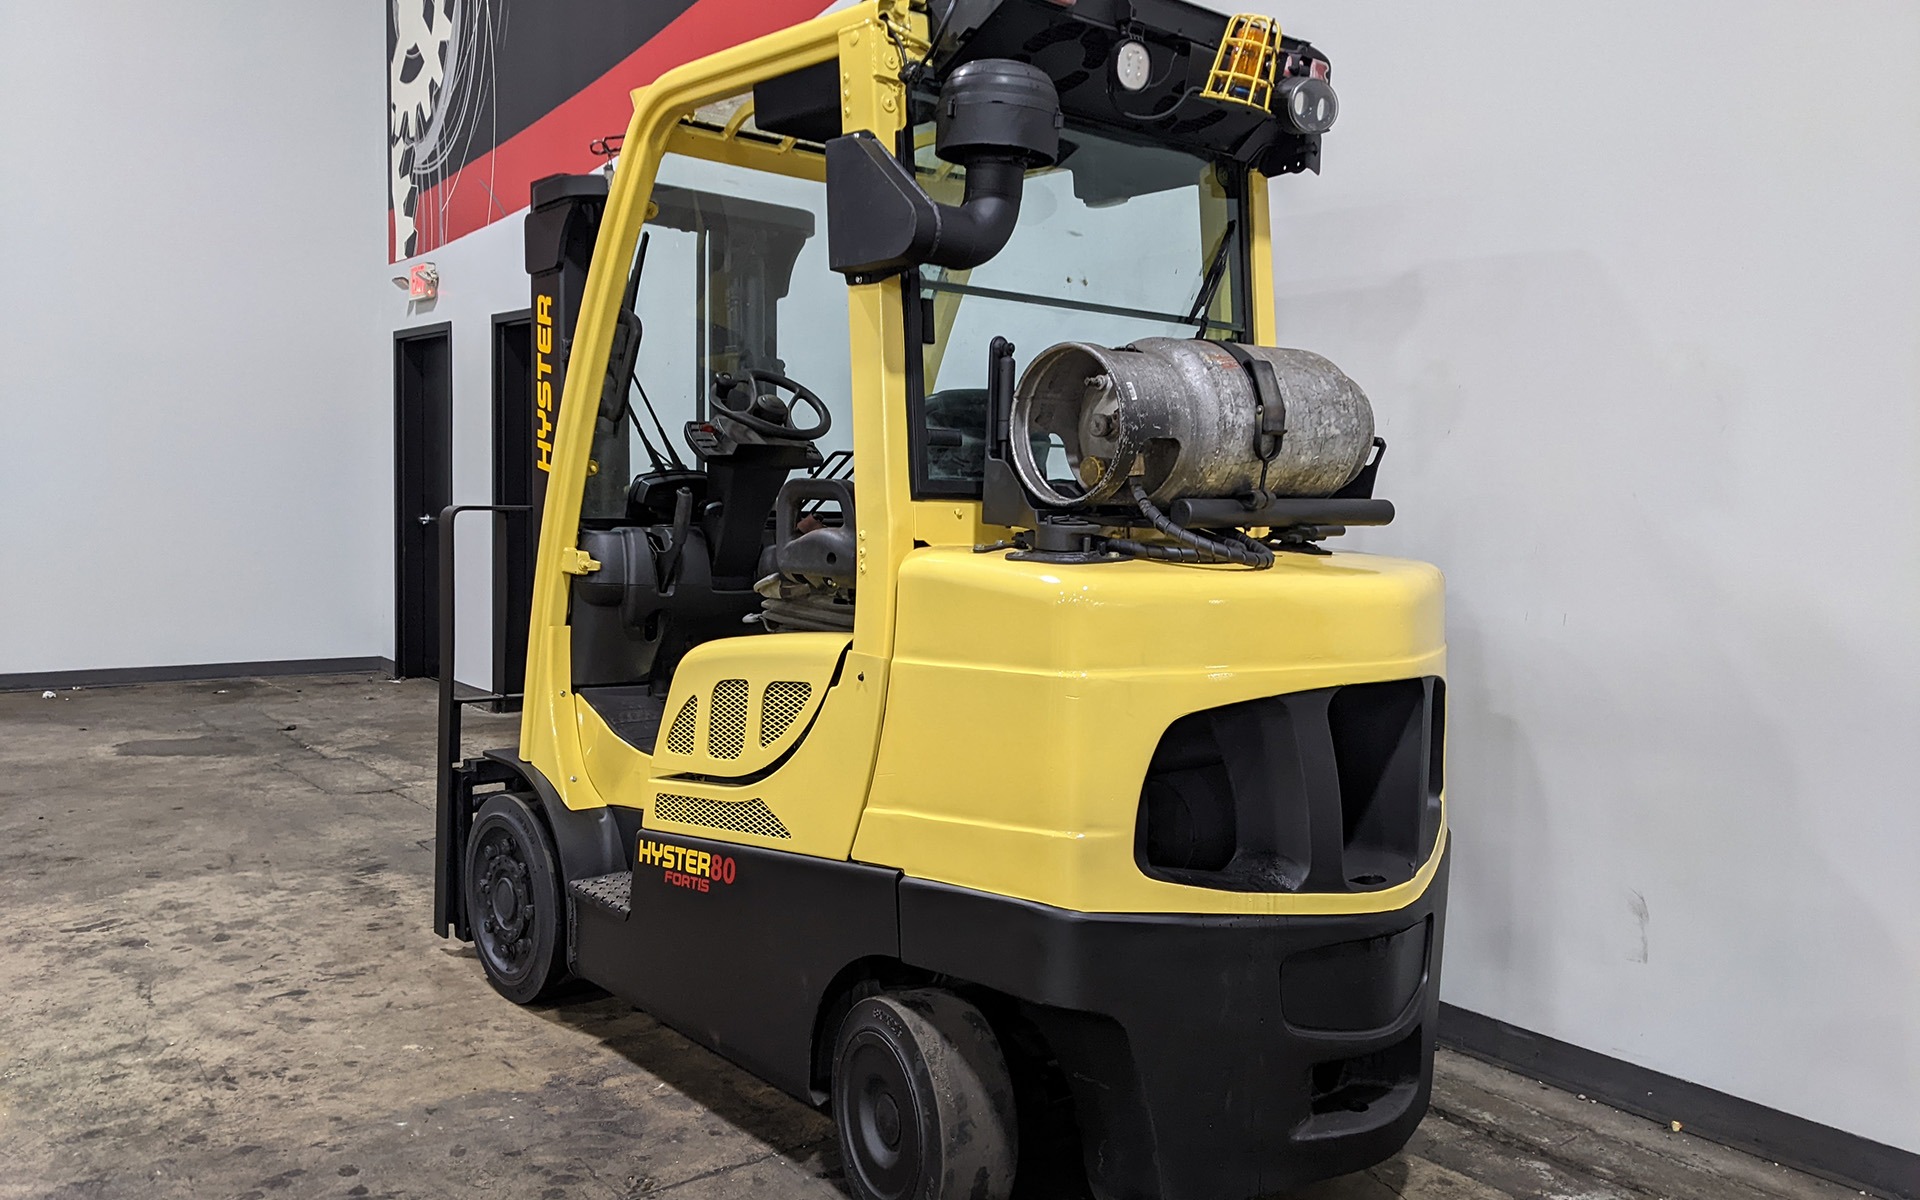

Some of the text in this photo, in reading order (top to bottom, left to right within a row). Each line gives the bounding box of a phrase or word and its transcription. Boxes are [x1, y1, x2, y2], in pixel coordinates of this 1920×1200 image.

[537, 295, 552, 473] HYSTER
[638, 839, 711, 878] HYSTER
[664, 870, 710, 893] FORTIS
